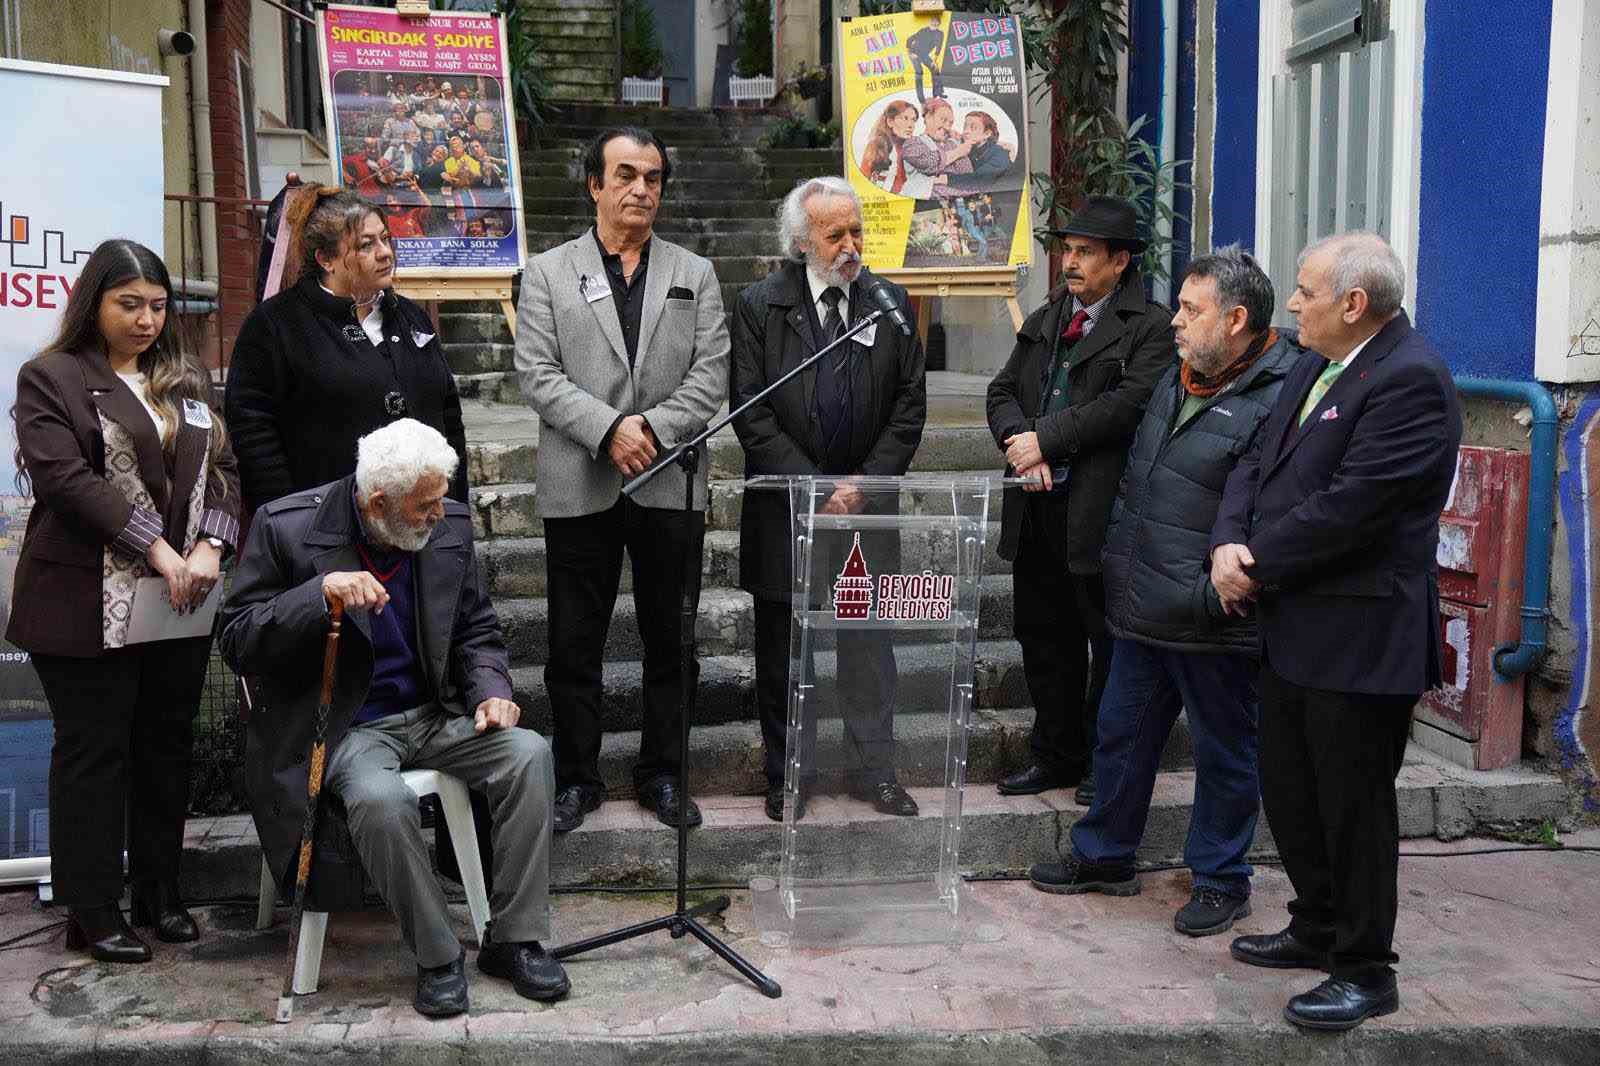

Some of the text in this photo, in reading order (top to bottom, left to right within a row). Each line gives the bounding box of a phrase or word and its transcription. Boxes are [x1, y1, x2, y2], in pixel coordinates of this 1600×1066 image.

[458, 19, 493, 29] SOLAK
[952, 17, 1015, 40] DEDE
[864, 31, 898, 54] AH
[950, 39, 1014, 66] DEDE
[857, 55, 906, 78] VAH
[879, 570, 953, 600] BEYOĞLU
[877, 600, 951, 619] BELEDİYESİ
